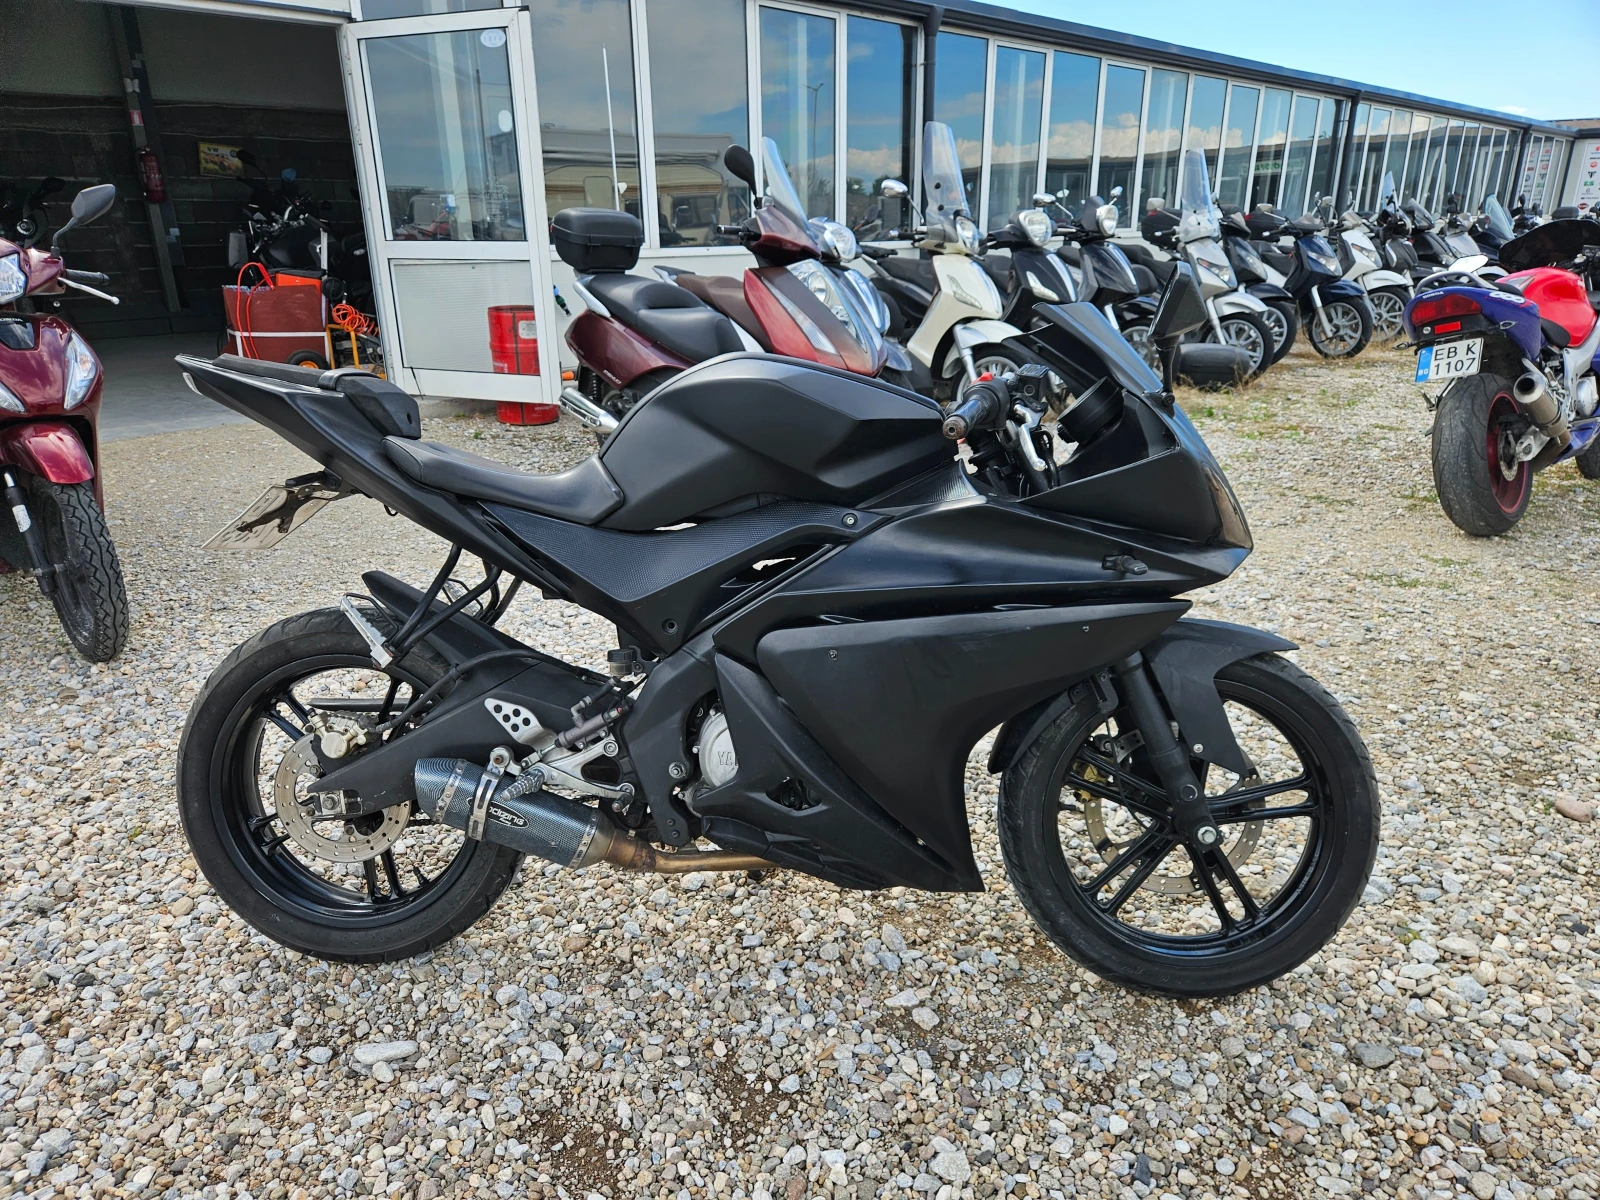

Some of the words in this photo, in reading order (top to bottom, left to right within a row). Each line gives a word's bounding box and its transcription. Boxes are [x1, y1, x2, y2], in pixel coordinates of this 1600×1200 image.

[1422, 290, 1444, 299] HONDA
[1434, 346, 1458, 361] EB
[1465, 342, 1477, 356] K
[1434, 357, 1477, 376] 1107
[717, 751, 738, 767] YA
